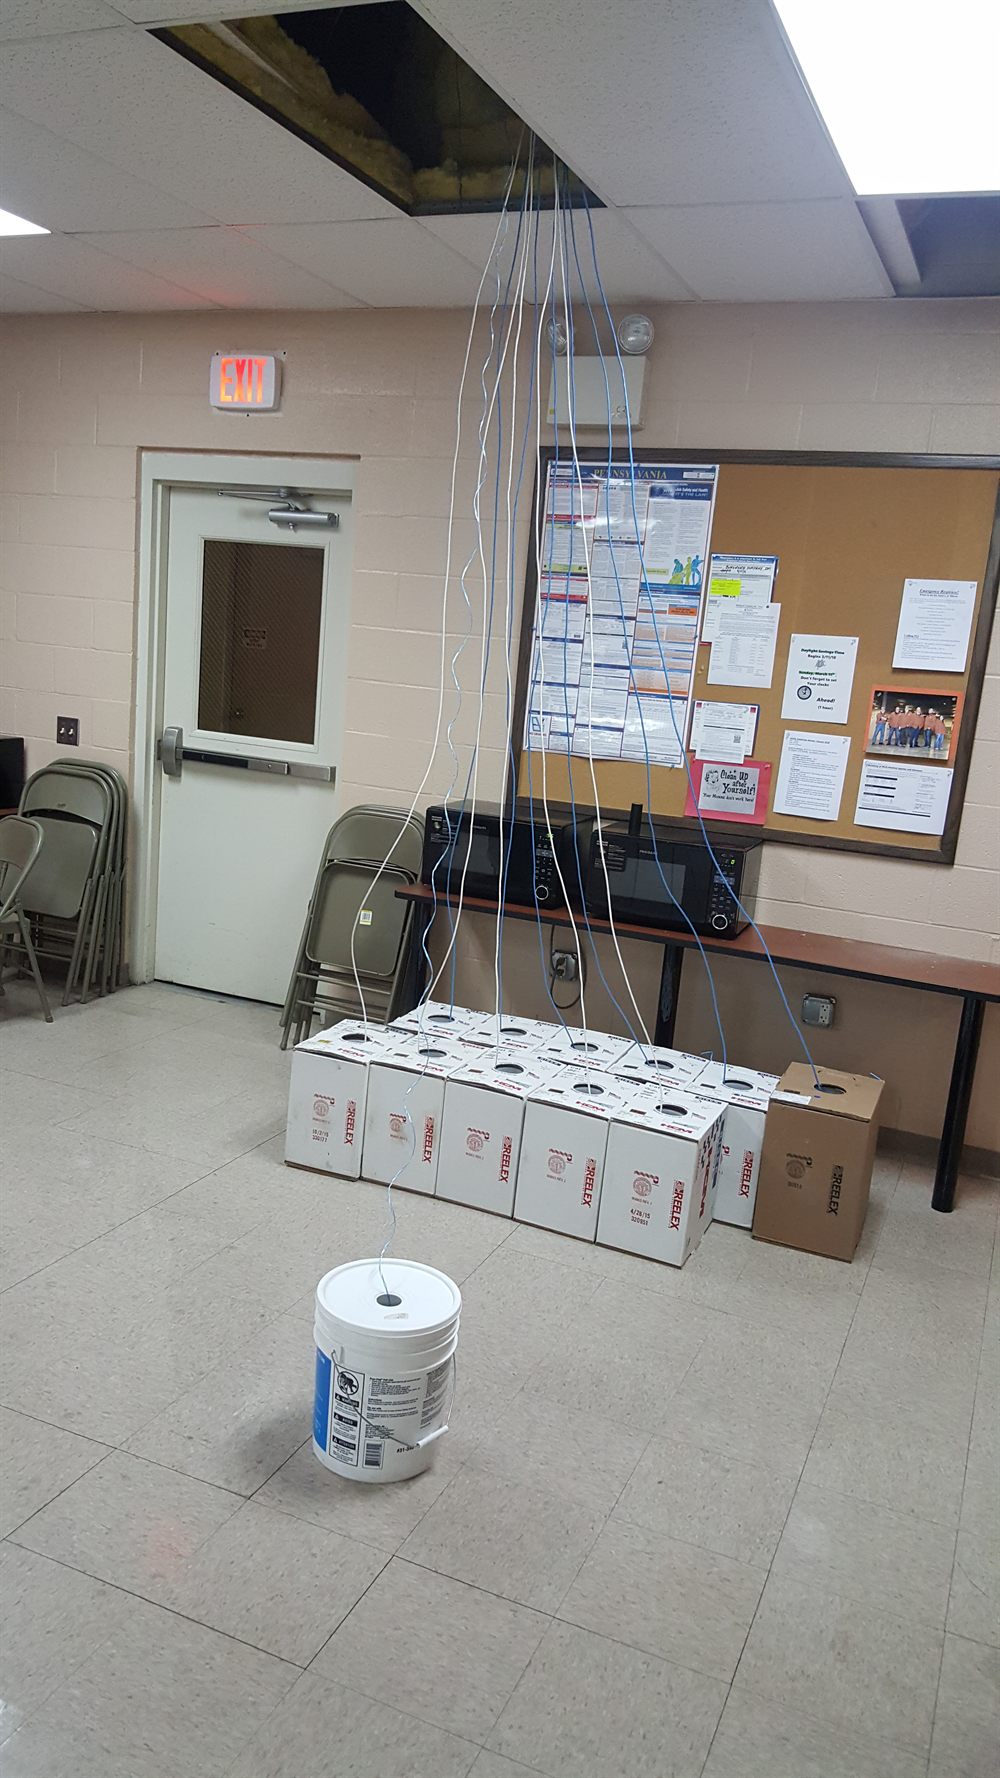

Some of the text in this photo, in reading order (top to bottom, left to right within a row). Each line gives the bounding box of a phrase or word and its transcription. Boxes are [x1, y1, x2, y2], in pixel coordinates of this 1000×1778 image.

[220, 358, 267, 403] EXIT
[594, 469, 668, 480] PENNSYVANIA
[720, 769, 737, 781] Clean
[722, 783, 756, 796] Yourself!
[732, 780, 748, 788] after
[344, 1110, 356, 1147] REELEX
[421, 1127, 434, 1164] REELEX
[498, 1146, 512, 1184] REELEX
[740, 1161, 753, 1199] REELEX
[582, 1169, 596, 1208] REELEX
[826, 1177, 843, 1217] REELEX
[670, 1191, 684, 1231] REELEX
